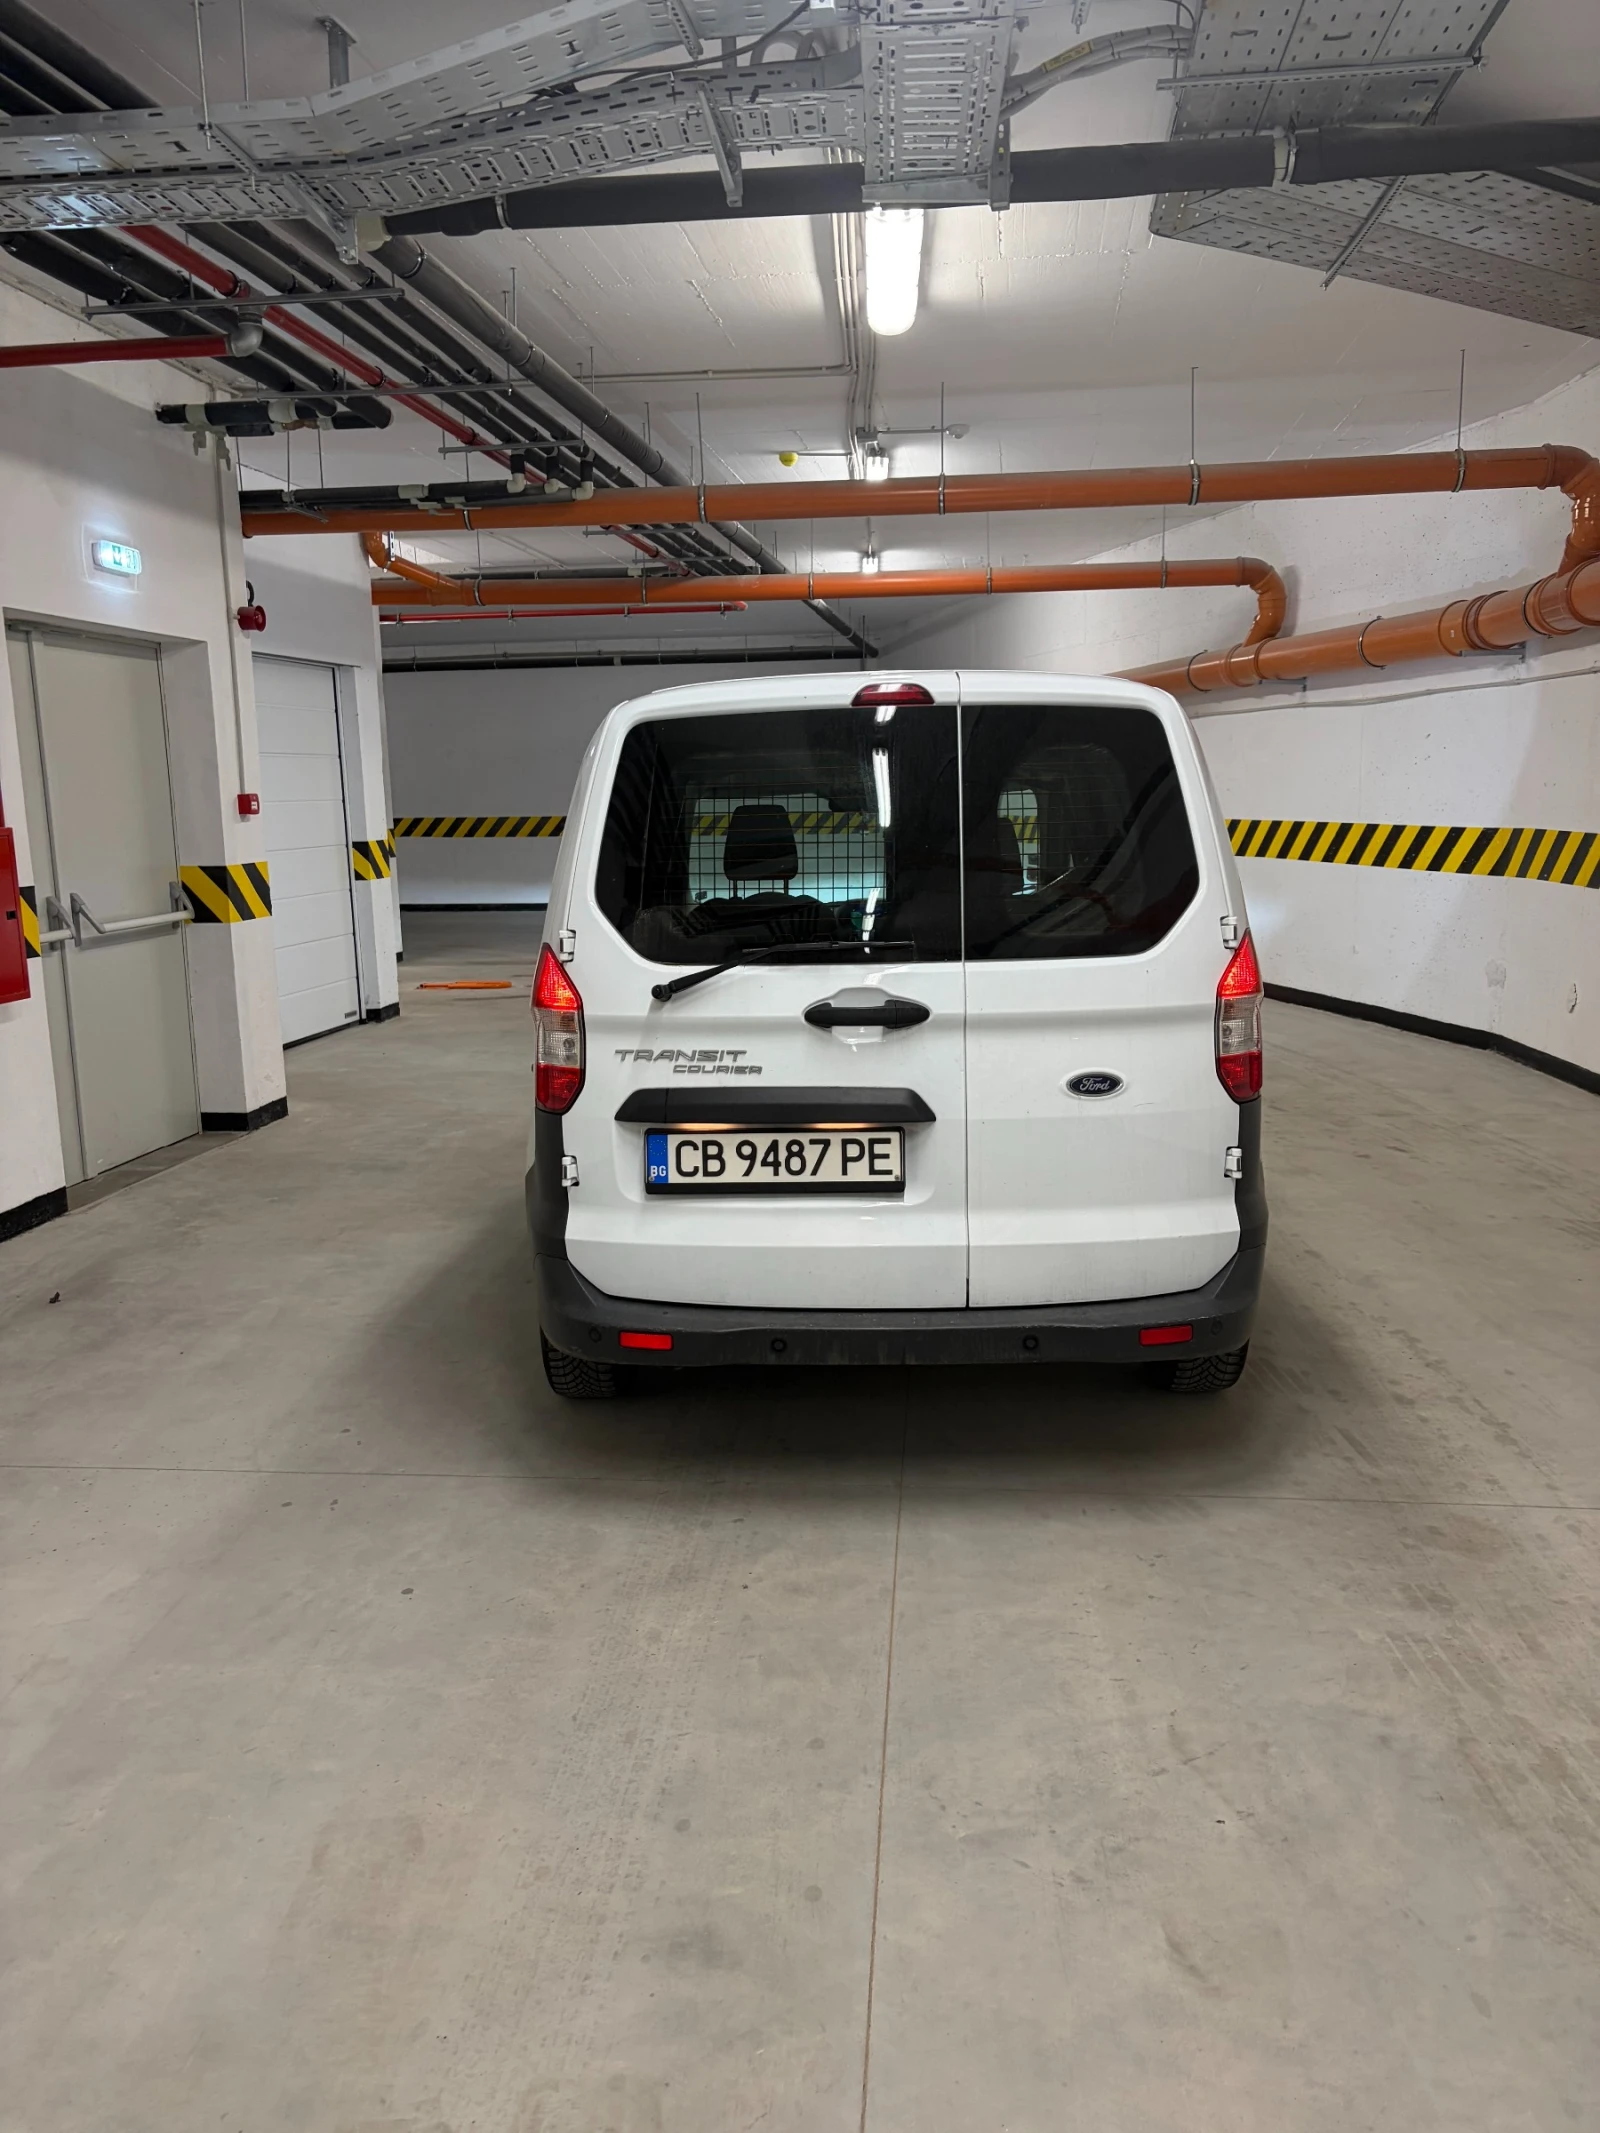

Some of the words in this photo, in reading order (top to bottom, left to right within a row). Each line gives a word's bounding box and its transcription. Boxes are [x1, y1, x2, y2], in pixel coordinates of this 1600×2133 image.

[614, 1049, 747, 1062] TRANSIT
[672, 1064, 763, 1075] COURIER
[1080, 1077, 1111, 1091] Ford
[675, 1139, 726, 1178] CB
[735, 1138, 831, 1177] 9487
[840, 1137, 894, 1176] PE
[650, 1165, 667, 1177] BG
